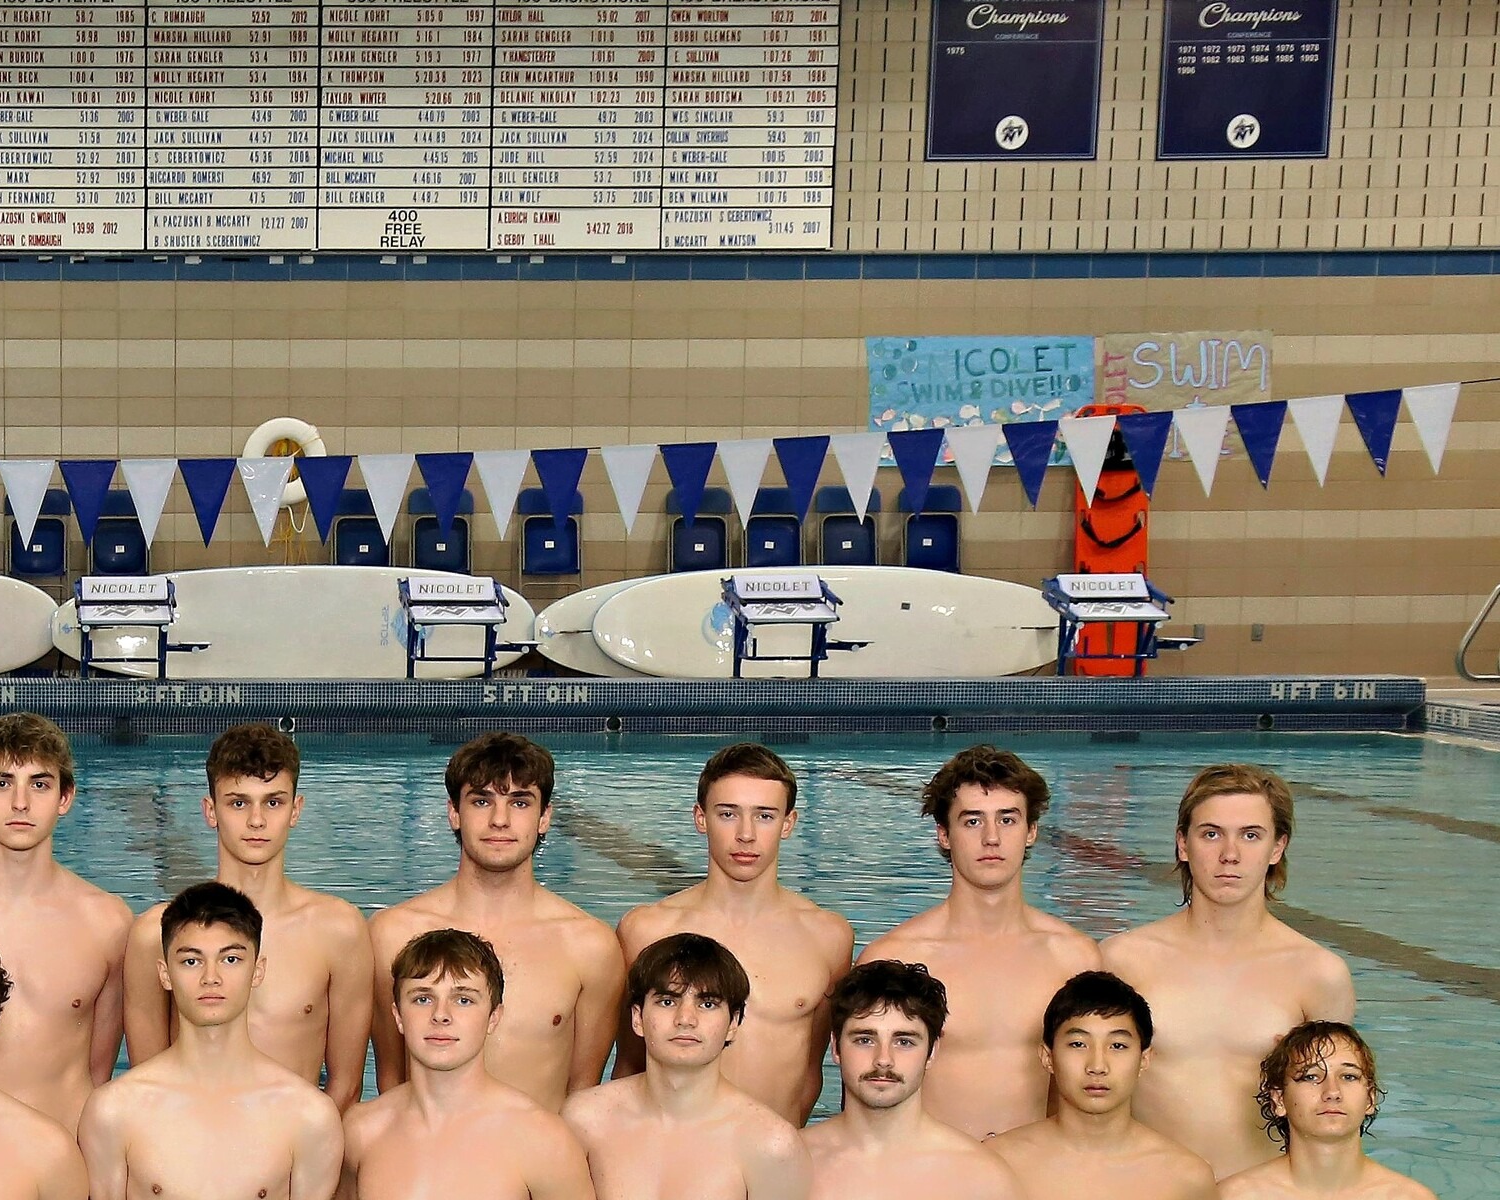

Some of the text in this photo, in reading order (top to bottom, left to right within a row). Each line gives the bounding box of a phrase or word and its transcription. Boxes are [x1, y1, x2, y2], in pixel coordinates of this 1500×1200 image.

[330, 10, 484, 22] NICOLE KOHRT 1997
[967, 4, 1069, 31] Champions
[1199, 2, 1302, 29] Champions
[674, 30, 826, 42] BOBBI CLEMENS 1981
[10, 51, 44, 63] BURDICK
[116, 51, 133, 63] 1976
[155, 51, 307, 63] SARAH GENGLER 1979
[342, 71, 384, 82] THOMPSON
[462, 71, 481, 82] 2023
[501, 71, 574, 82] ERIN MACARTHUR
[17, 92, 44, 103] KAWAI
[116, 91, 135, 103] 2019
[155, 91, 308, 103] NICOLE KOHRT 1997
[501, 91, 654, 103] DELANIE NIKOLAY 2019
[673, 91, 826, 102] SARAH BOOTSMA 2005
[673, 110, 824, 122] WES SINCLAIR 1987
[168, 152, 224, 163] CEBERTOWICZ
[290, 151, 309, 163] 2008
[500, 151, 653, 163] JUDE HILL 2024
[9, 192, 54, 203] FERNANDEZ
[116, 192, 135, 203] 2023
[326, 191, 477, 203] BILL GENGLER 1979
[669, 191, 821, 203] BEN WILLMAN 1989
[389, 210, 417, 222] 400
[385, 223, 421, 234] FREE
[381, 236, 425, 247] RELAY
[1128, 340, 1267, 391] SWIM
[897, 381, 963, 402] SWIM
[992, 374, 1062, 397] DIVE!!
[91, 585, 156, 593] NICOLET
[420, 585, 485, 593] NICOLET
[746, 582, 812, 591] NICOLET
[1072, 581, 1135, 590] NICOLET
